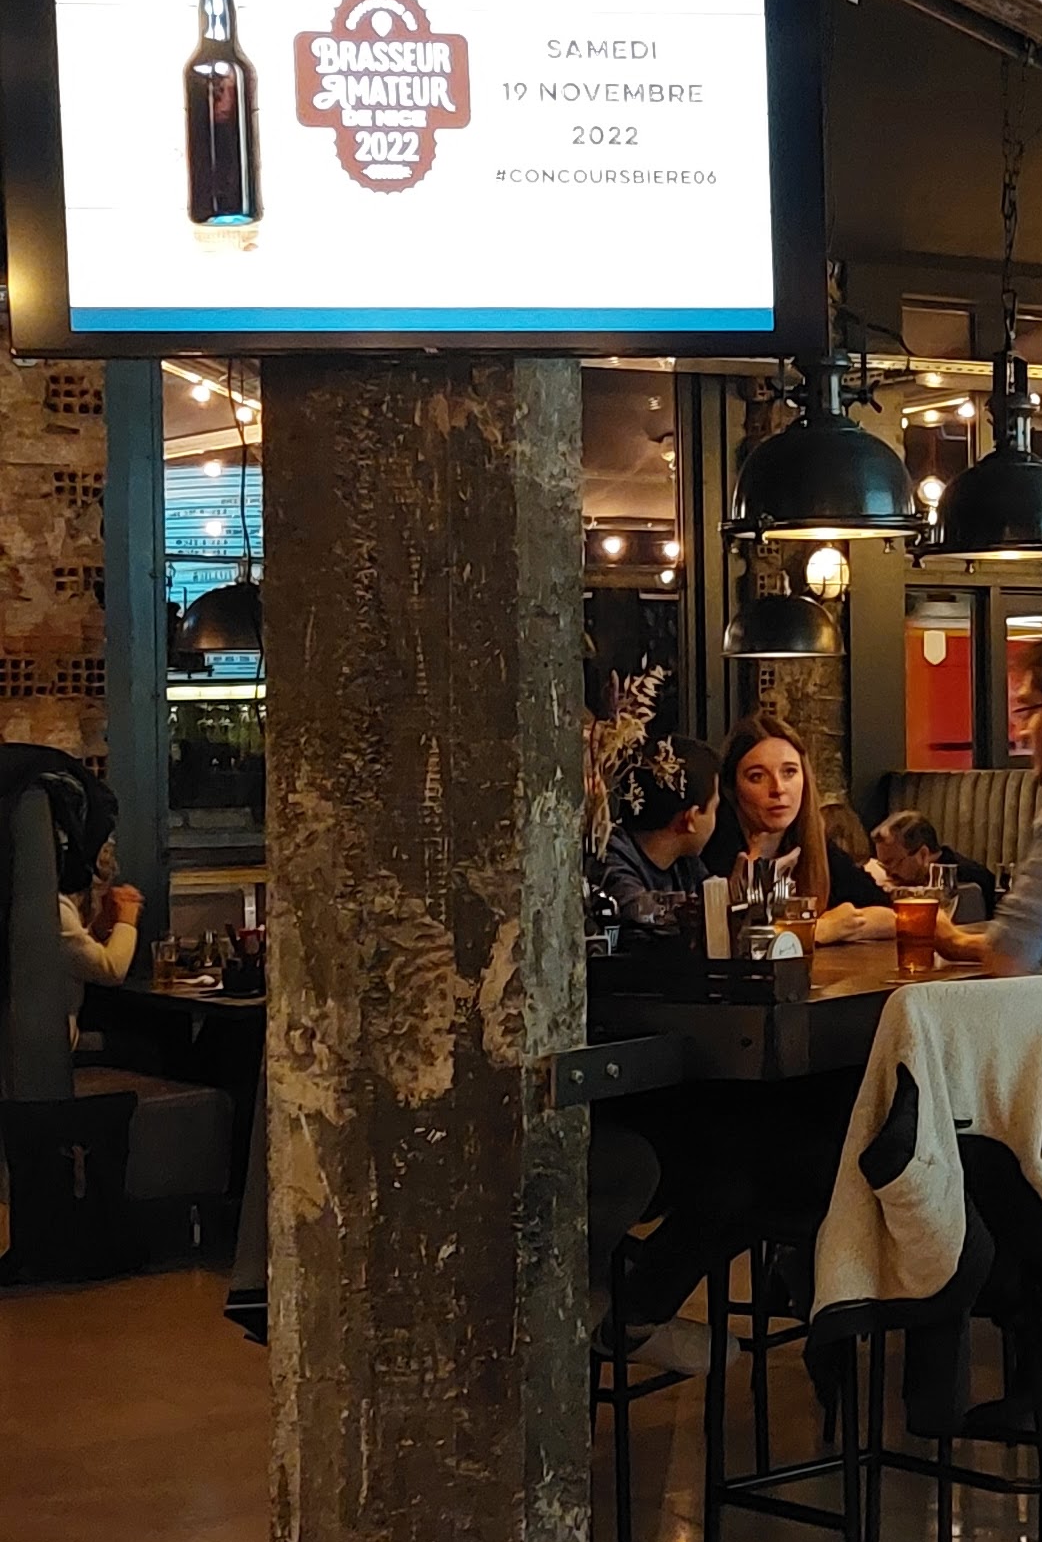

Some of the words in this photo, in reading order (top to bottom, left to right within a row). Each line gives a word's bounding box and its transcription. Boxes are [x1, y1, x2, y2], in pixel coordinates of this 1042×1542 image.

[310, 36, 452, 74] BRASSEUR
[547, 39, 657, 60] SAMEDI
[312, 74, 456, 113] AMATEUR
[502, 82, 528, 101] 19
[539, 82, 703, 103] NOVEMBRE
[572, 125, 638, 145] 2022
[354, 131, 420, 162] 2022
[495, 169, 717, 185] #CONCOURSBIERE06
